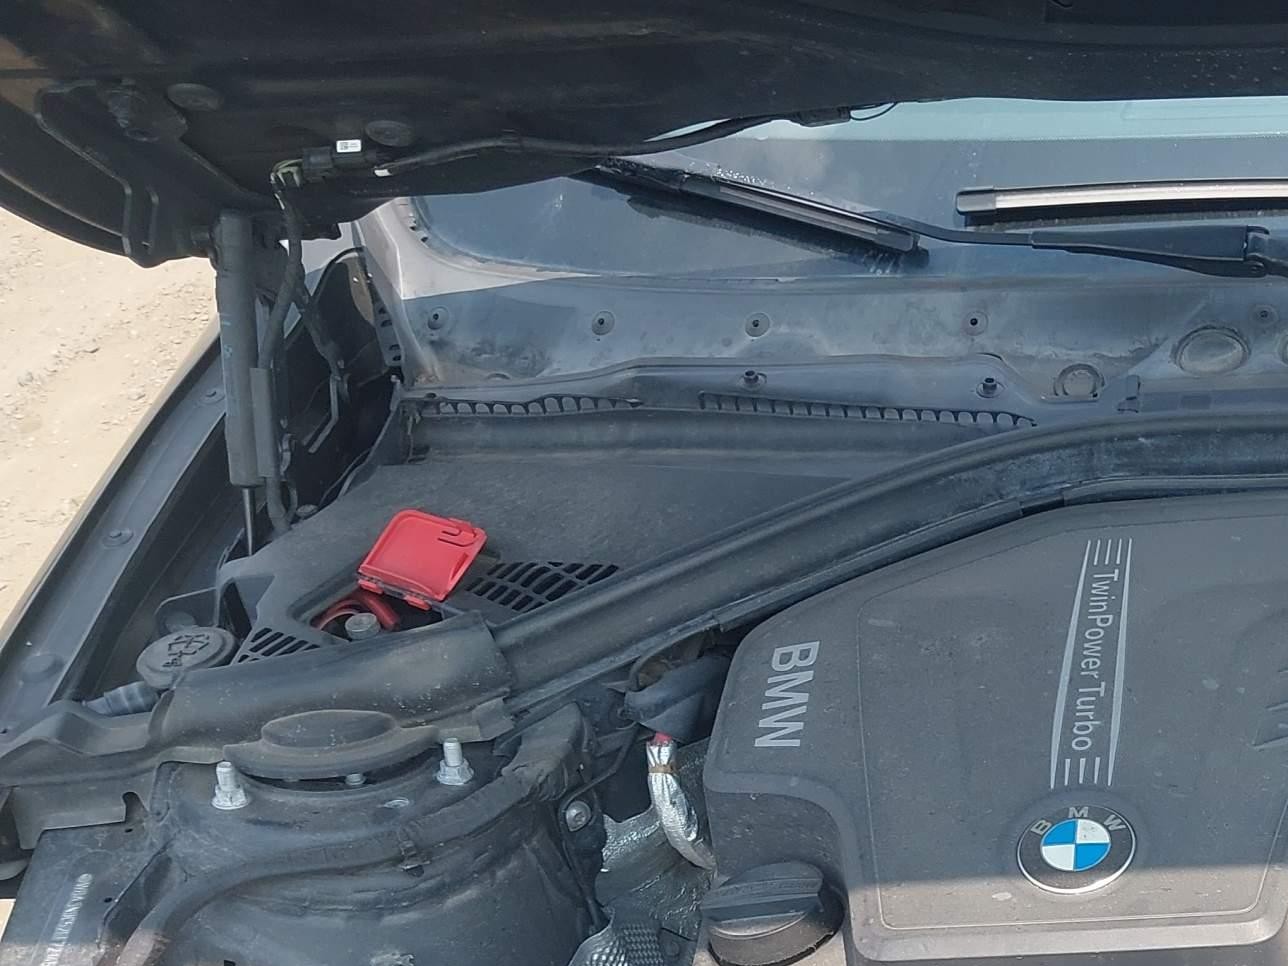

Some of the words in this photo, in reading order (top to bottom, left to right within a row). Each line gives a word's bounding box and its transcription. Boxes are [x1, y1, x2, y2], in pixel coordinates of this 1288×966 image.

[1078, 568, 1119, 679] TwinPower
[754, 641, 820, 747] BMW
[1071, 681, 1107, 751] Turbo
[1030, 806, 1126, 835] BMW
